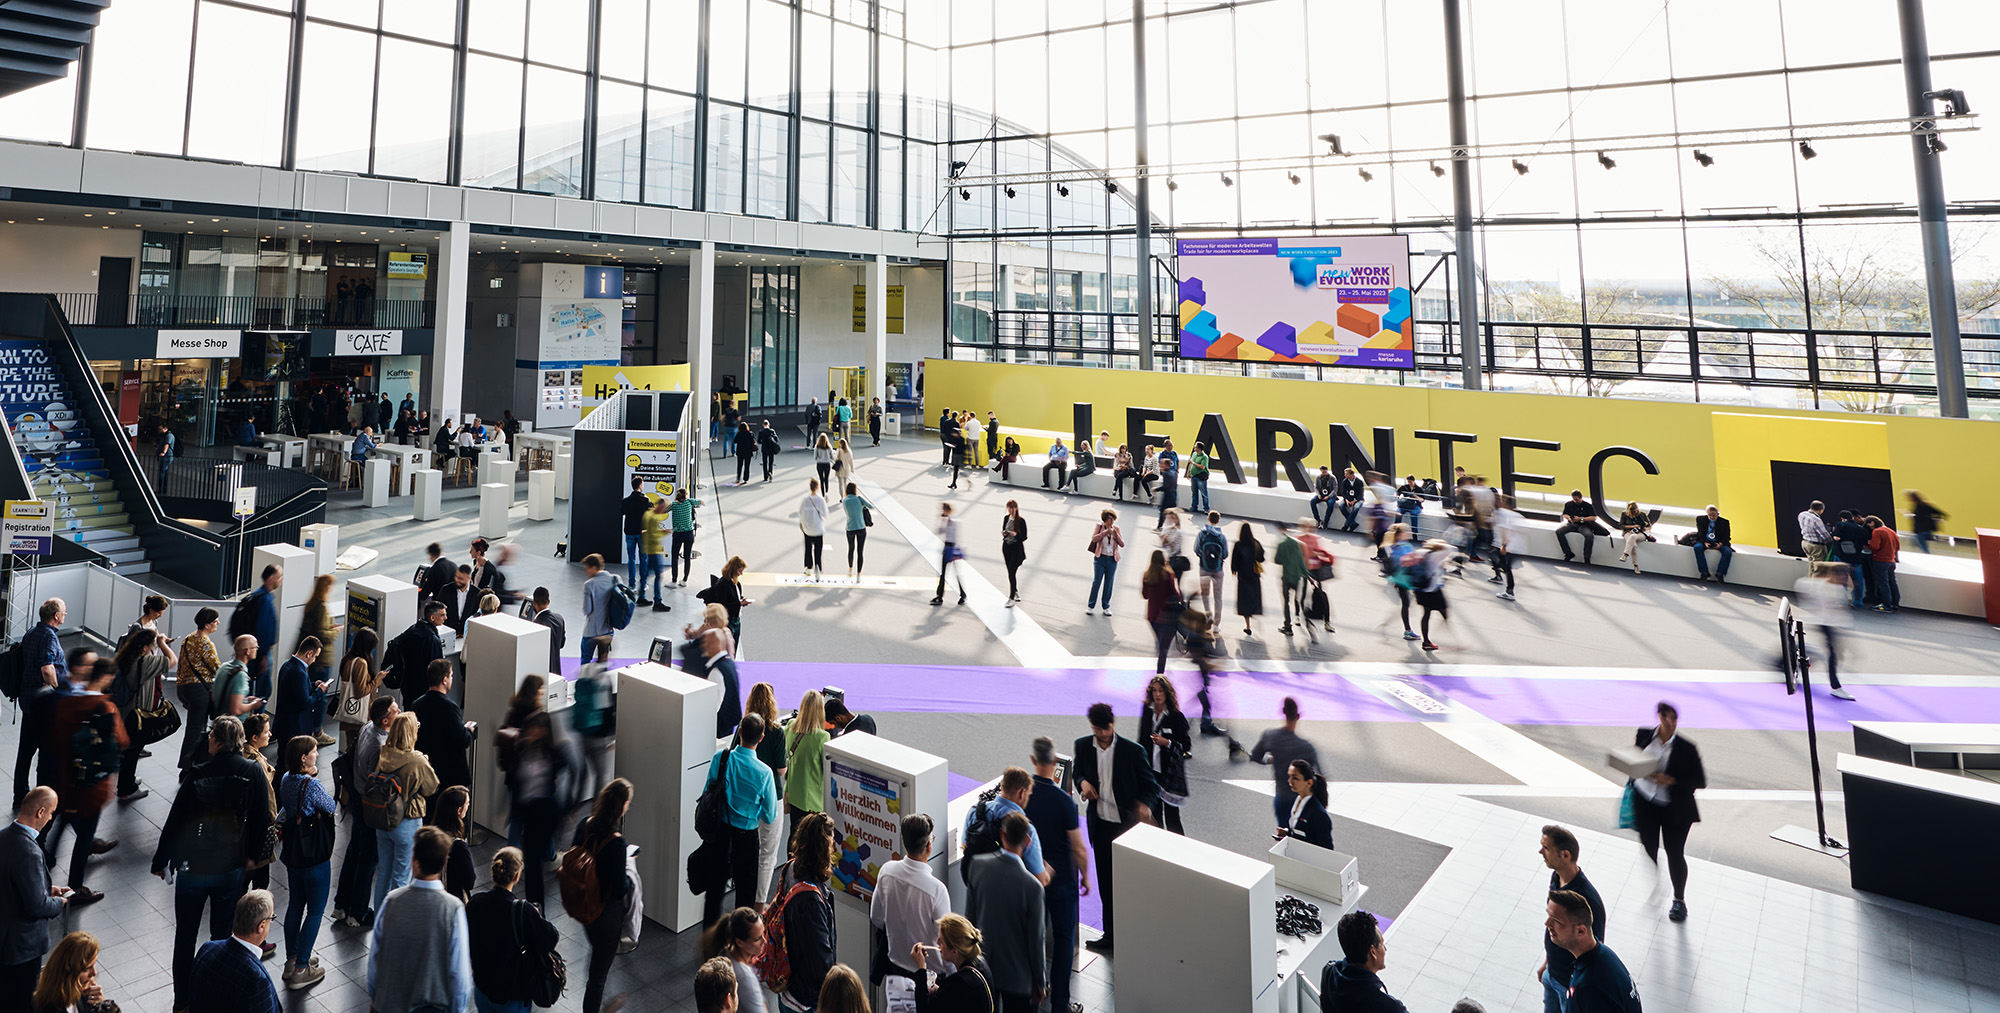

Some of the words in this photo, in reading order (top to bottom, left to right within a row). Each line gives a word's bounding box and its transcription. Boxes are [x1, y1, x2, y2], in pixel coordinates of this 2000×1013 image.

[1322, 268, 1352, 278] new
[1351, 266, 1390, 276] WORK
[1320, 276, 1390, 286] EVOLUTION
[170, 339, 202, 348] Messe
[204, 338, 228, 349] Shop
[354, 332, 391, 353] CAFÉ
[22, 349, 48, 364] TO
[0, 368, 22, 382] PE
[22, 367, 56, 381] THE
[4, 523, 50, 532] Registration
[840, 787, 880, 812] Herzlich
[834, 799, 896, 834] Willkommen
[844, 820, 892, 851] Welcome!
